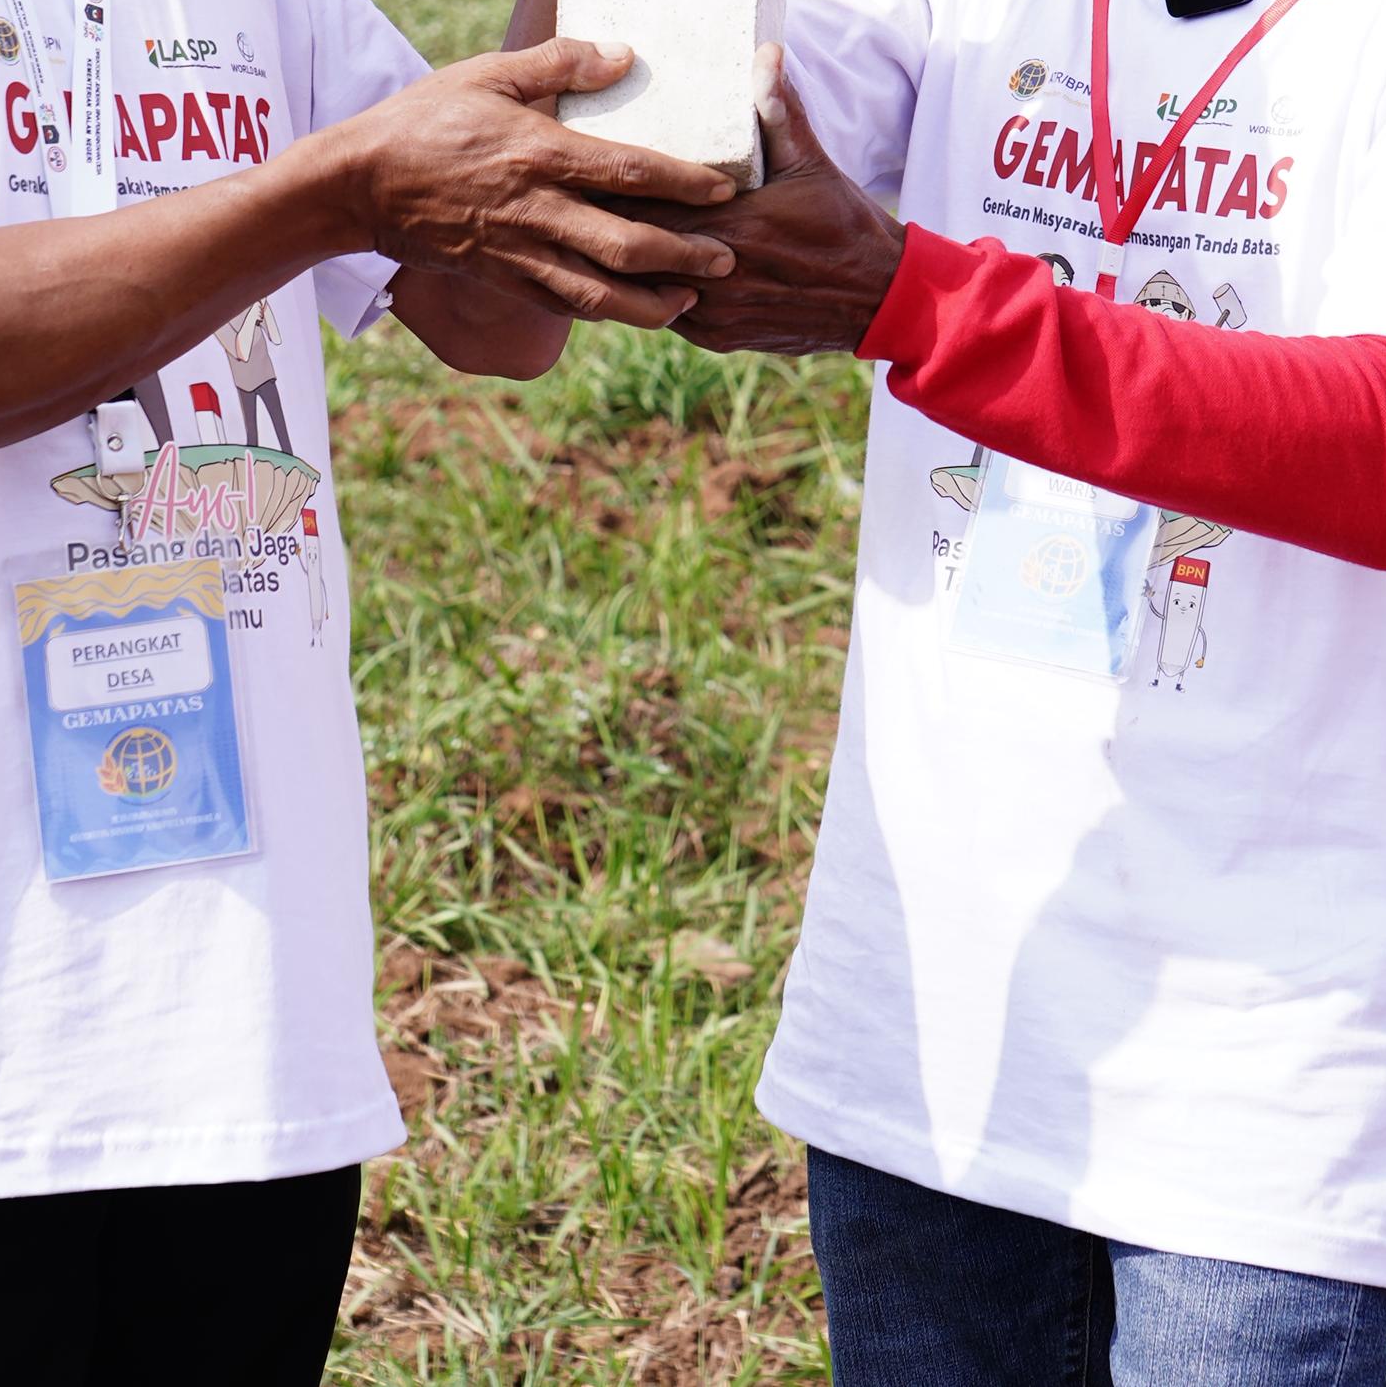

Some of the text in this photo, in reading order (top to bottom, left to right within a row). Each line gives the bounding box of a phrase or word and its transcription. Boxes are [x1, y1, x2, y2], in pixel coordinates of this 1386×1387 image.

[1033, 206, 1105, 240] Masyaraka
[1124, 230, 1191, 254] emasangan
[1195, 233, 1239, 255] Tanda
[1241, 238, 1281, 256] Batas
[1009, 502, 1126, 538] GEMAPATAS
[67, 528, 299, 571] Pasang dan Jaga
[1176, 564, 1205, 580] BPN
[72, 633, 182, 663] PERANGKAT
[107, 668, 154, 688] DESA
[62, 696, 204, 730] GEMAPATAS
